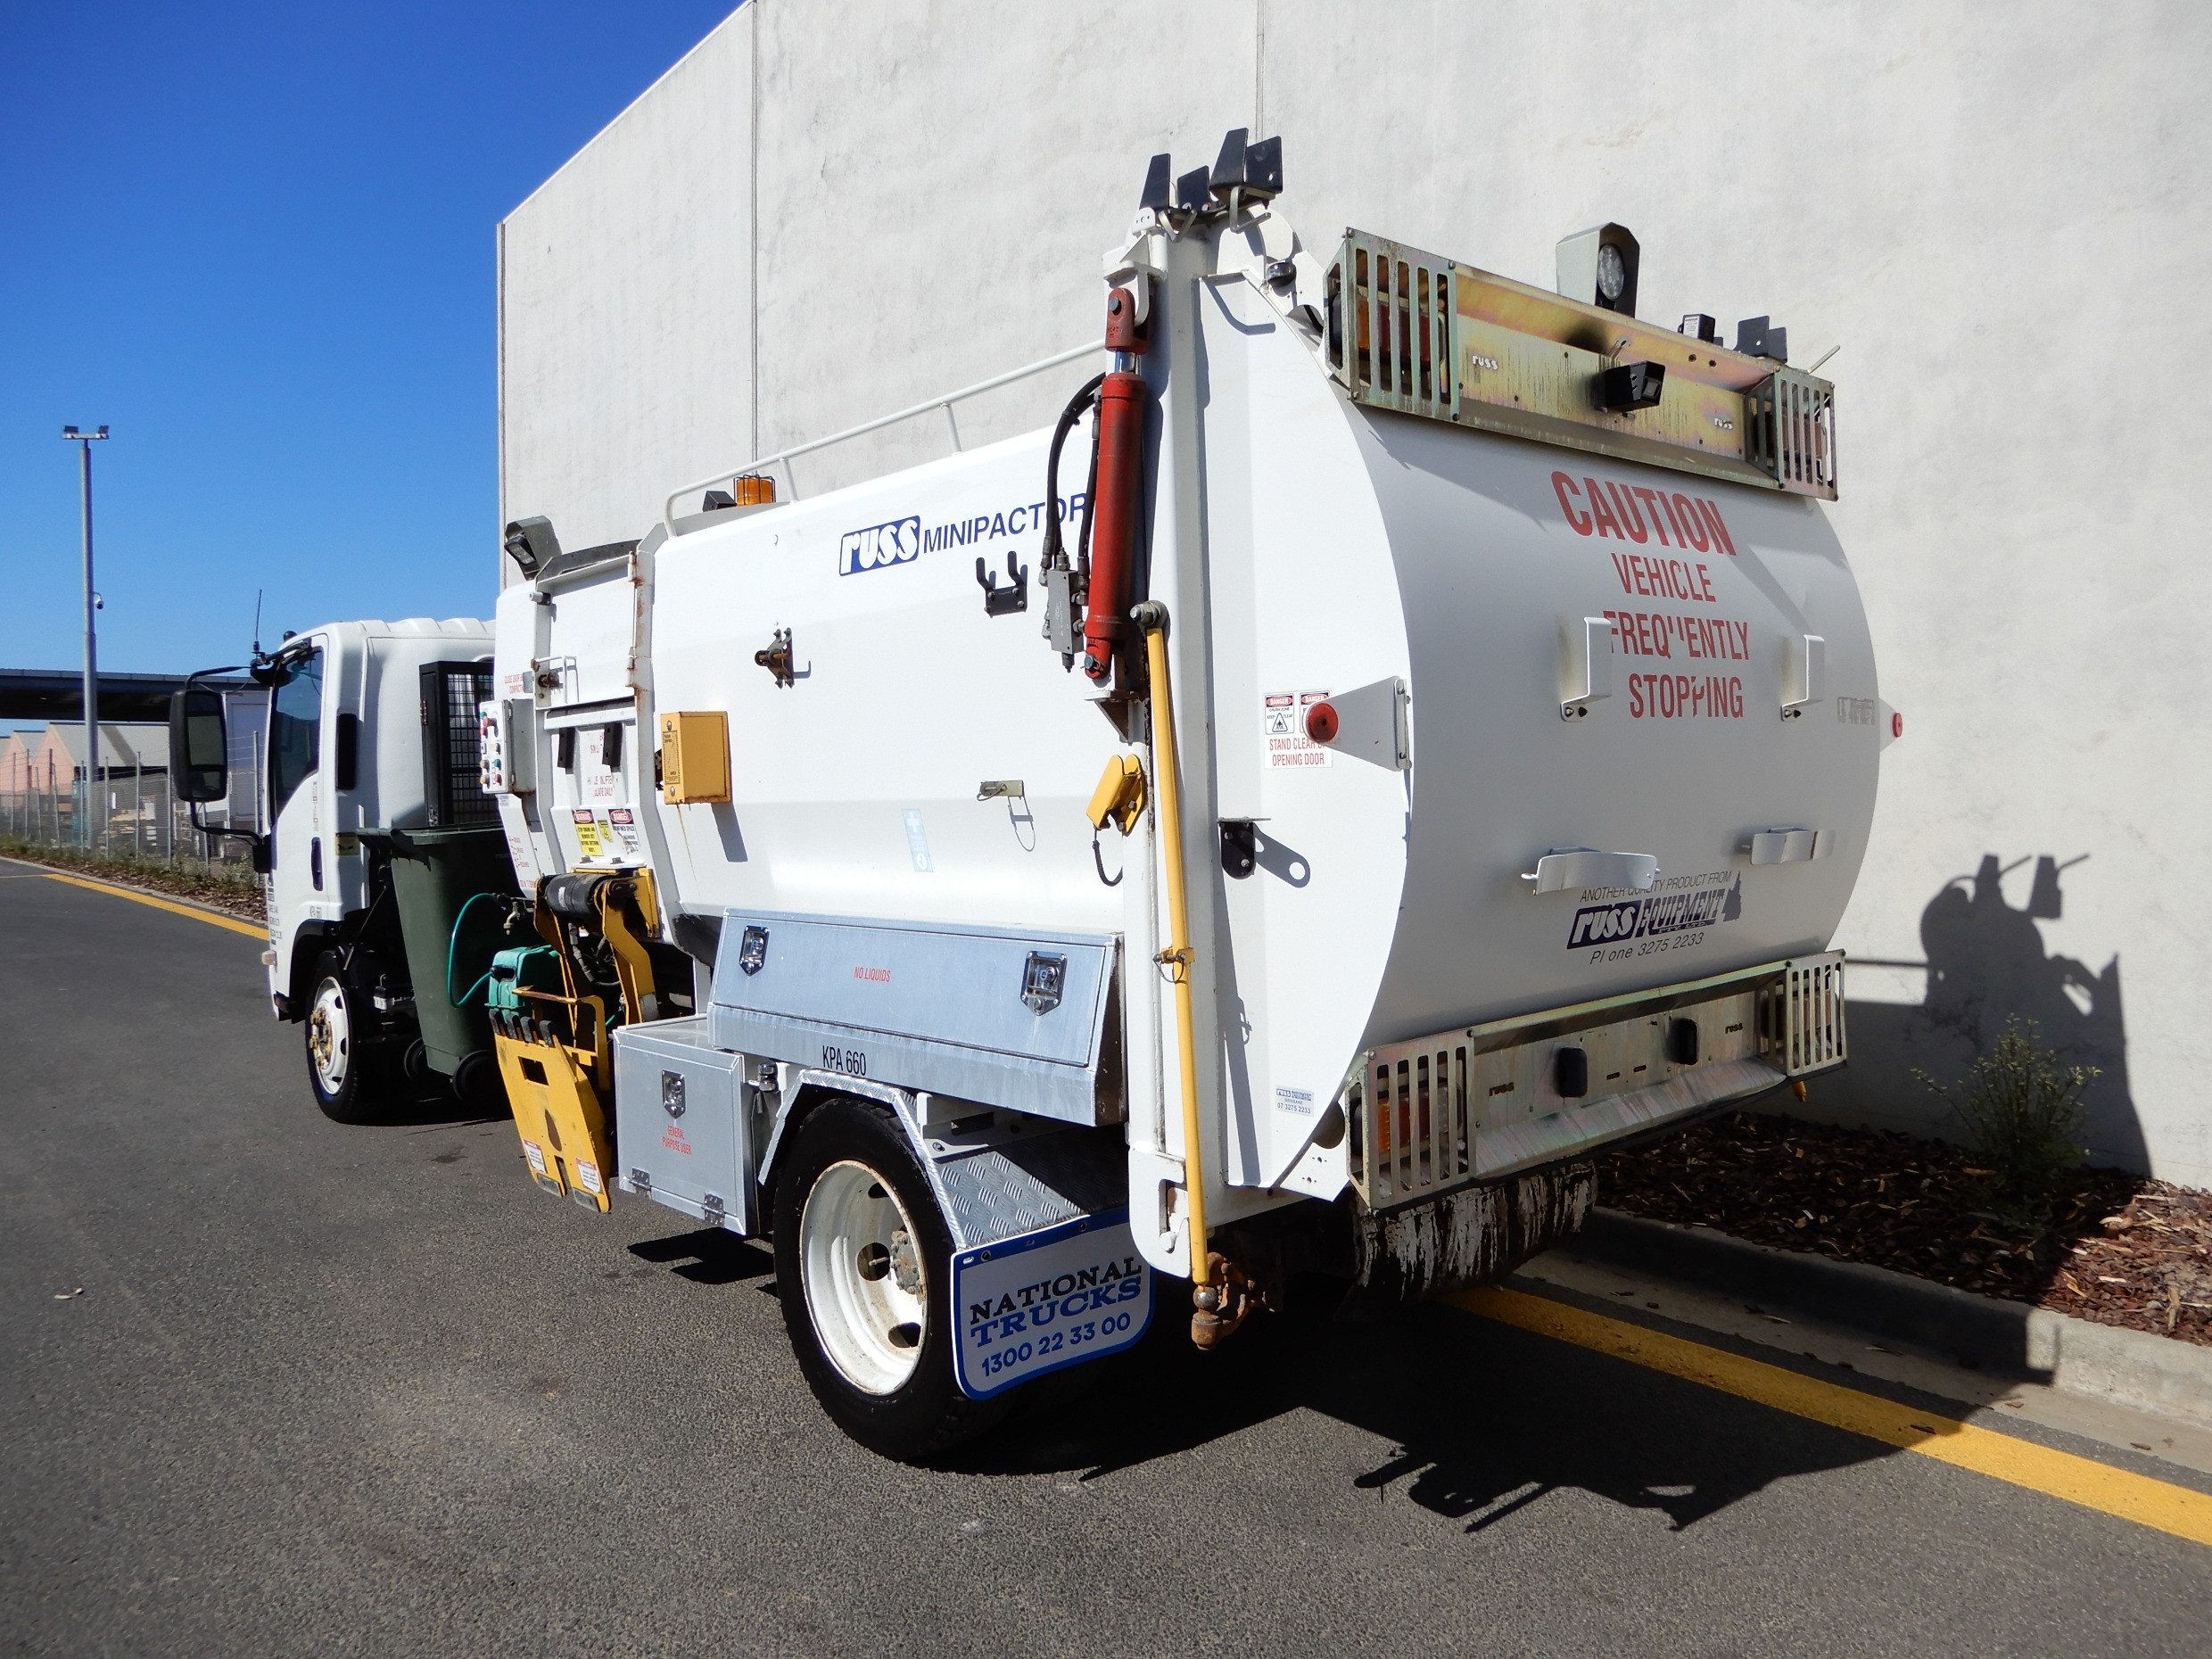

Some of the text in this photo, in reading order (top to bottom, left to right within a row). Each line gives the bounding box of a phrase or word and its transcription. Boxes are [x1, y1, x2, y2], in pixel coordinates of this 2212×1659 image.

[1551, 471, 1737, 556] CAUTION
[1611, 552, 1716, 602] VEHICLE
[1629, 673, 1744, 718] STOPPING
[1269, 739, 1292, 751] STAND
[1273, 753, 1325, 766] OPENING DOOR
[1666, 873, 1707, 891] PRODUCT
[1707, 871, 1732, 885] FROM
[1636, 888, 1726, 937] EQUIPMENT
[1638, 938, 1670, 956] 3275
[1672, 932, 1704, 949] 2233
[854, 967, 891, 982] NO LIQUIDS
[822, 1044, 866, 1076] KPA 660
[970, 1257, 1143, 1325] NATIONAL
[970, 1275, 1143, 1348] TRUCKS
[981, 1312, 1131, 1377] 1300 22 33 00
